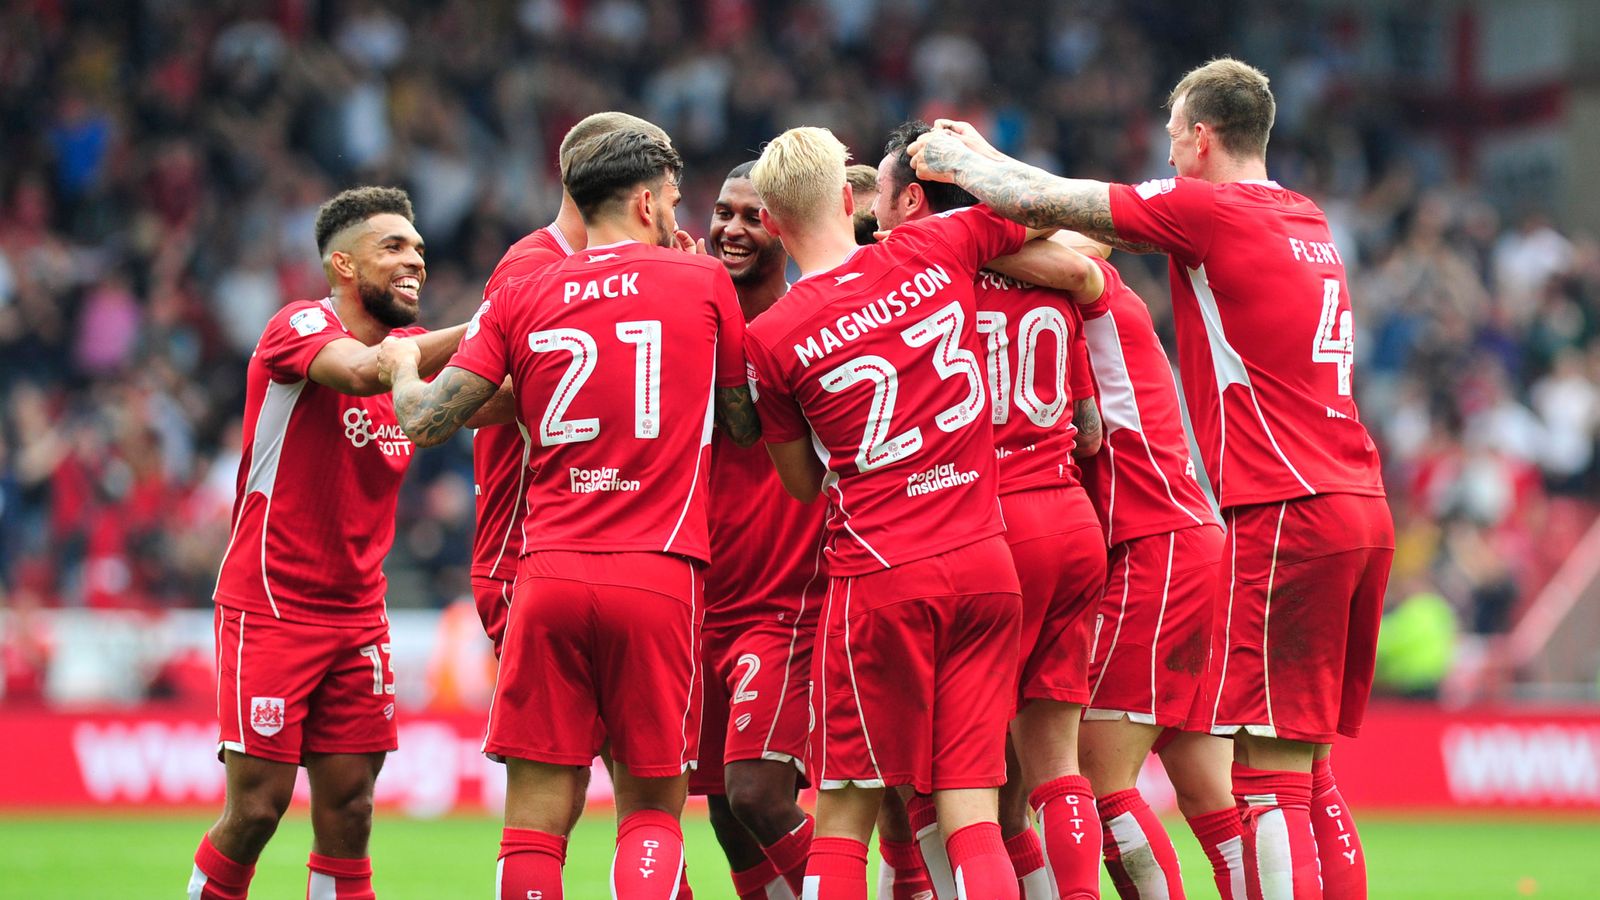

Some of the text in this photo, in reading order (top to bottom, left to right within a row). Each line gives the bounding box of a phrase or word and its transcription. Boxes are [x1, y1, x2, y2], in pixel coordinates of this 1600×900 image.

[563, 272, 640, 303] PACK
[793, 264, 951, 368] MAGNUSSON
[1312, 279, 1353, 396] 4
[528, 320, 662, 447] 21
[819, 301, 985, 474] 23
[977, 306, 1069, 427] 10
[569, 466, 619, 484] Poplar
[571, 478, 640, 494] Insulation
[907, 462, 955, 484] Poplar
[907, 470, 980, 498] Insulation
[733, 653, 760, 705] 2
[1065, 795, 1085, 844] CITY
[1325, 804, 1356, 865] CITY
[640, 839, 659, 879] CITY
